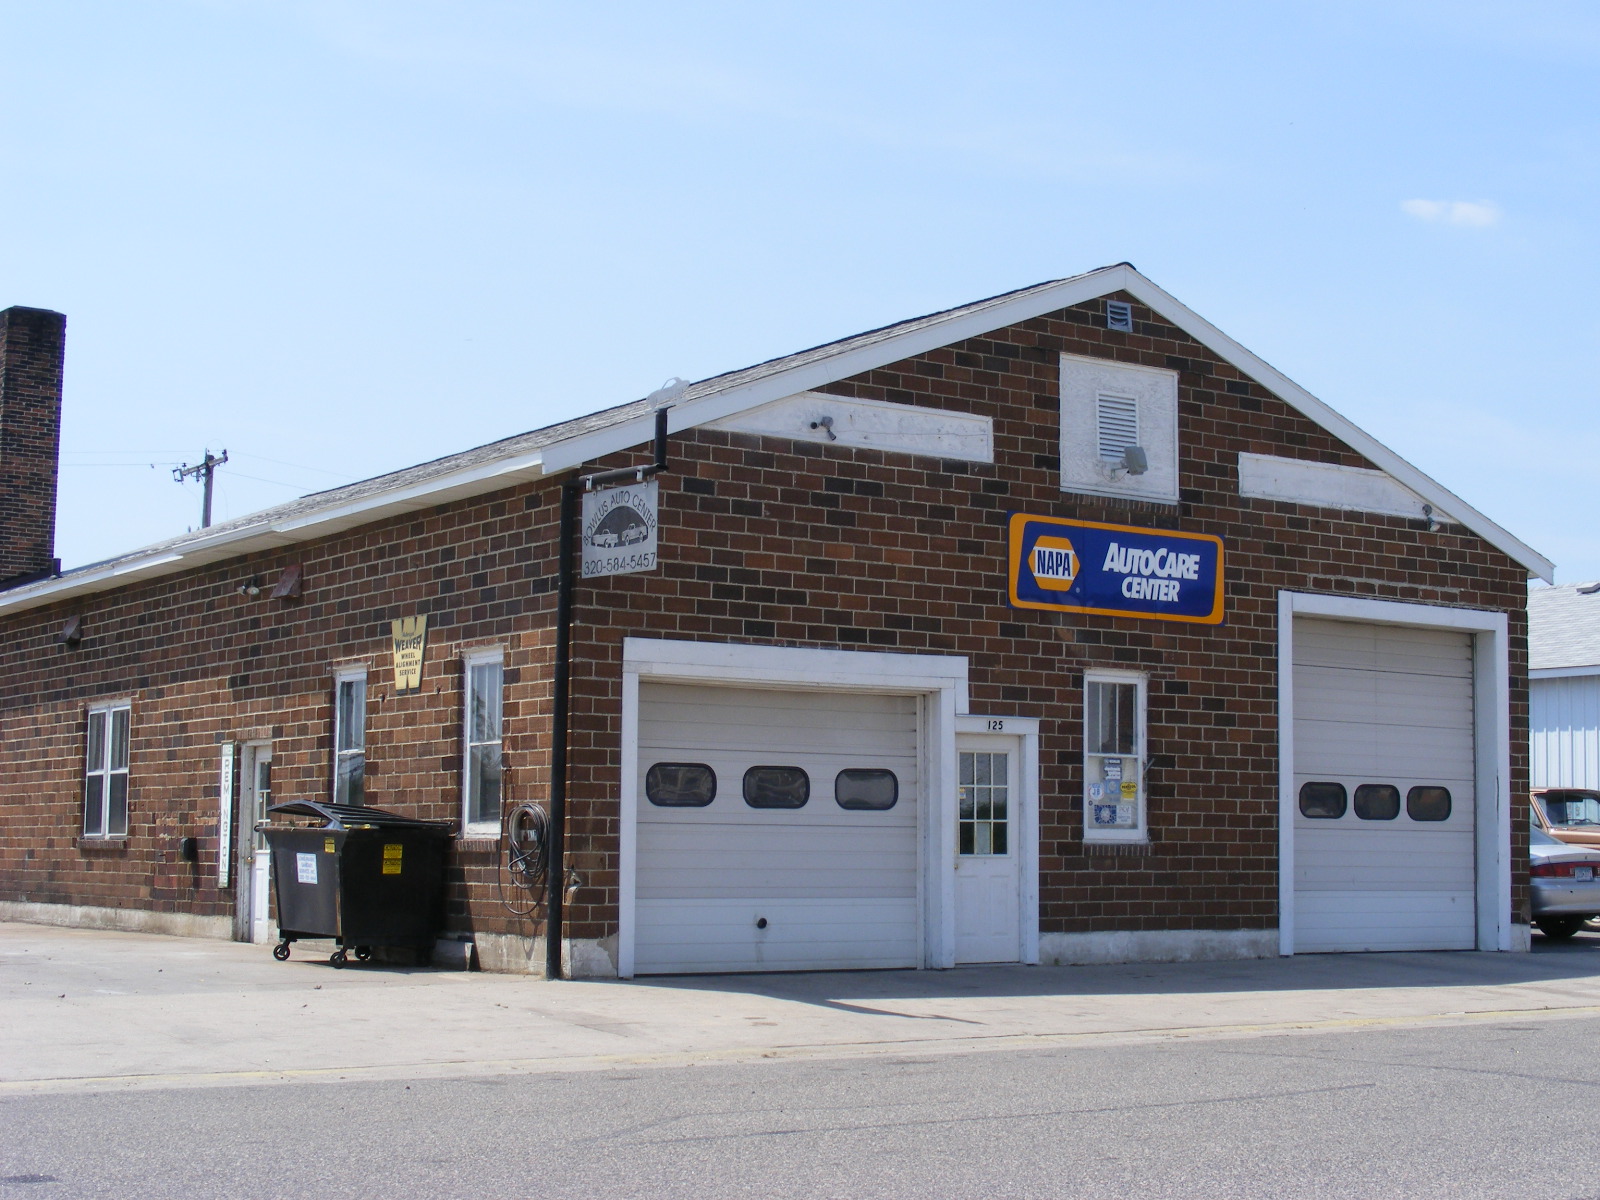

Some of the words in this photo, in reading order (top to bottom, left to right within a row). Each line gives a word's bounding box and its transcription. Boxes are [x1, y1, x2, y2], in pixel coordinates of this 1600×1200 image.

[583, 501, 609, 546] BOWLUS
[610, 490, 631, 506] AUTO
[632, 494, 656, 532] CENTER
[583, 552, 656, 576] 320-584-5457
[1037, 549, 1071, 577] NAPA
[1121, 576, 1181, 603] CENTER
[394, 634, 423, 655] WEAVER
[396, 660, 420, 669] ALIGNMENT
[987, 720, 1004, 730] 125
[221, 759, 230, 870] REMINGTON
